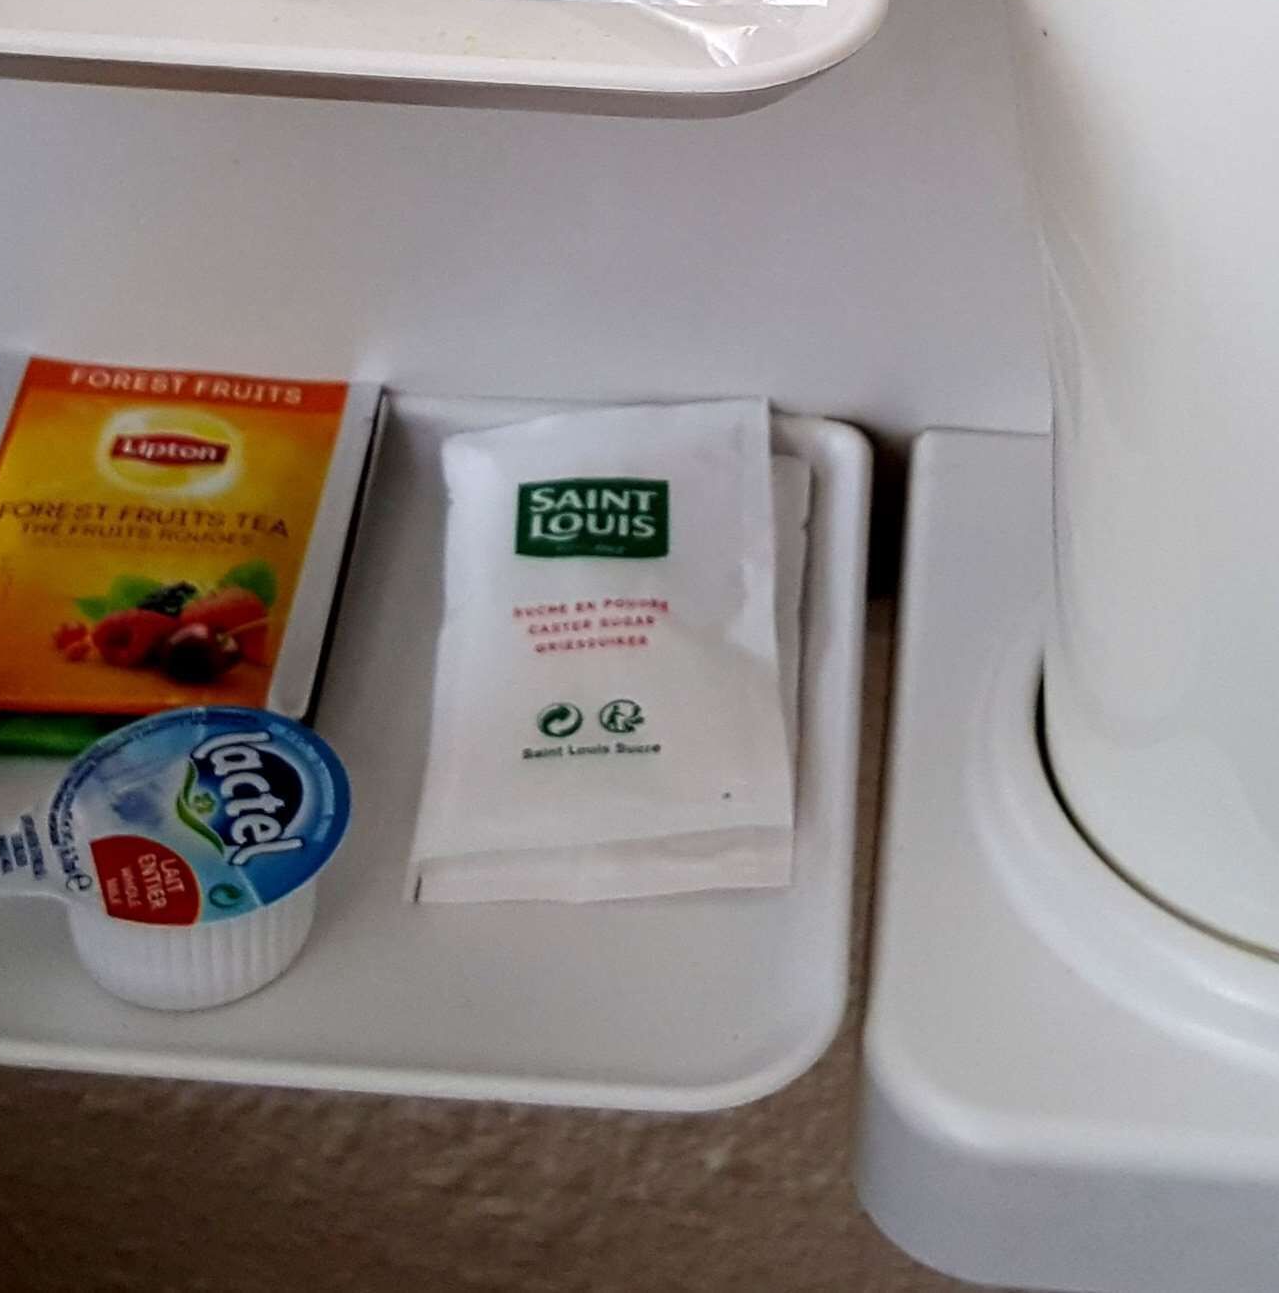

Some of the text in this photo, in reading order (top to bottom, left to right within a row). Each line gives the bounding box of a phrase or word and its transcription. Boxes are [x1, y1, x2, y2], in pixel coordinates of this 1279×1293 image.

[70, 368, 301, 404] FOREST FRUITS
[121, 436, 219, 464] Lipton
[529, 487, 659, 512] SAINT
[68, 524, 152, 541] FRUITS
[117, 504, 226, 528] FRUITS
[235, 512, 290, 539] TEA
[529, 512, 658, 541] LOUIS
[528, 614, 656, 635] CASTER SUGAR
[522, 740, 662, 760] Saint Louis Sucre
[137, 852, 168, 910] ENTIER
[160, 857, 186, 894] LAIT
